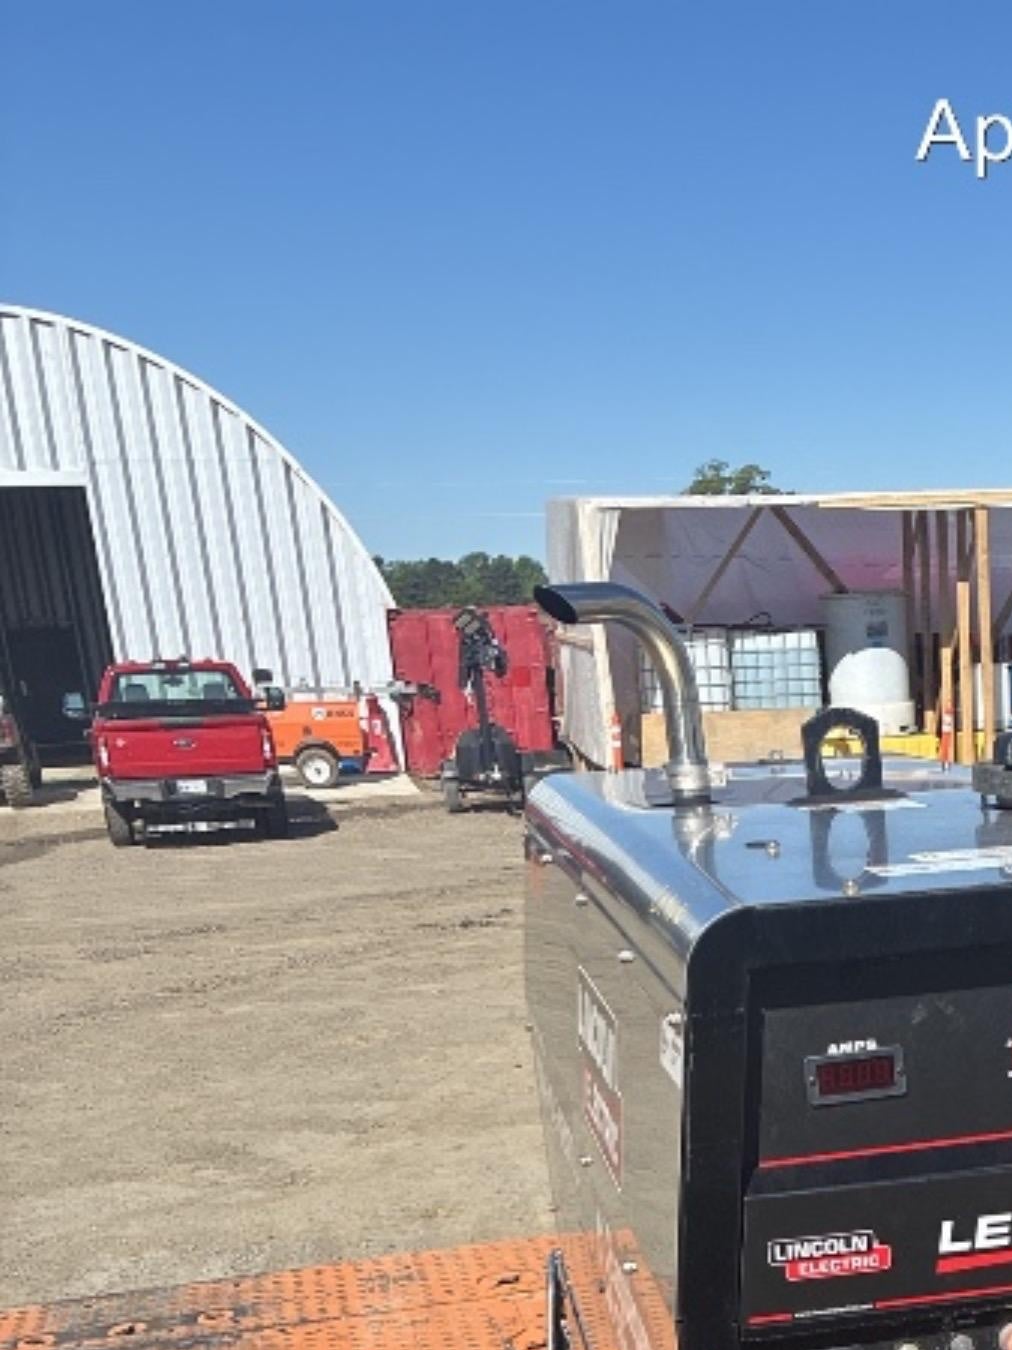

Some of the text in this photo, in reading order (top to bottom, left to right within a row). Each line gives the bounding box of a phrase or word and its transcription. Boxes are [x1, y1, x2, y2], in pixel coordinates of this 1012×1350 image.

[826, 1036, 878, 1055] AMPS
[773, 1234, 869, 1262] LINCOLN
[799, 1253, 881, 1277] ELECTRIC
